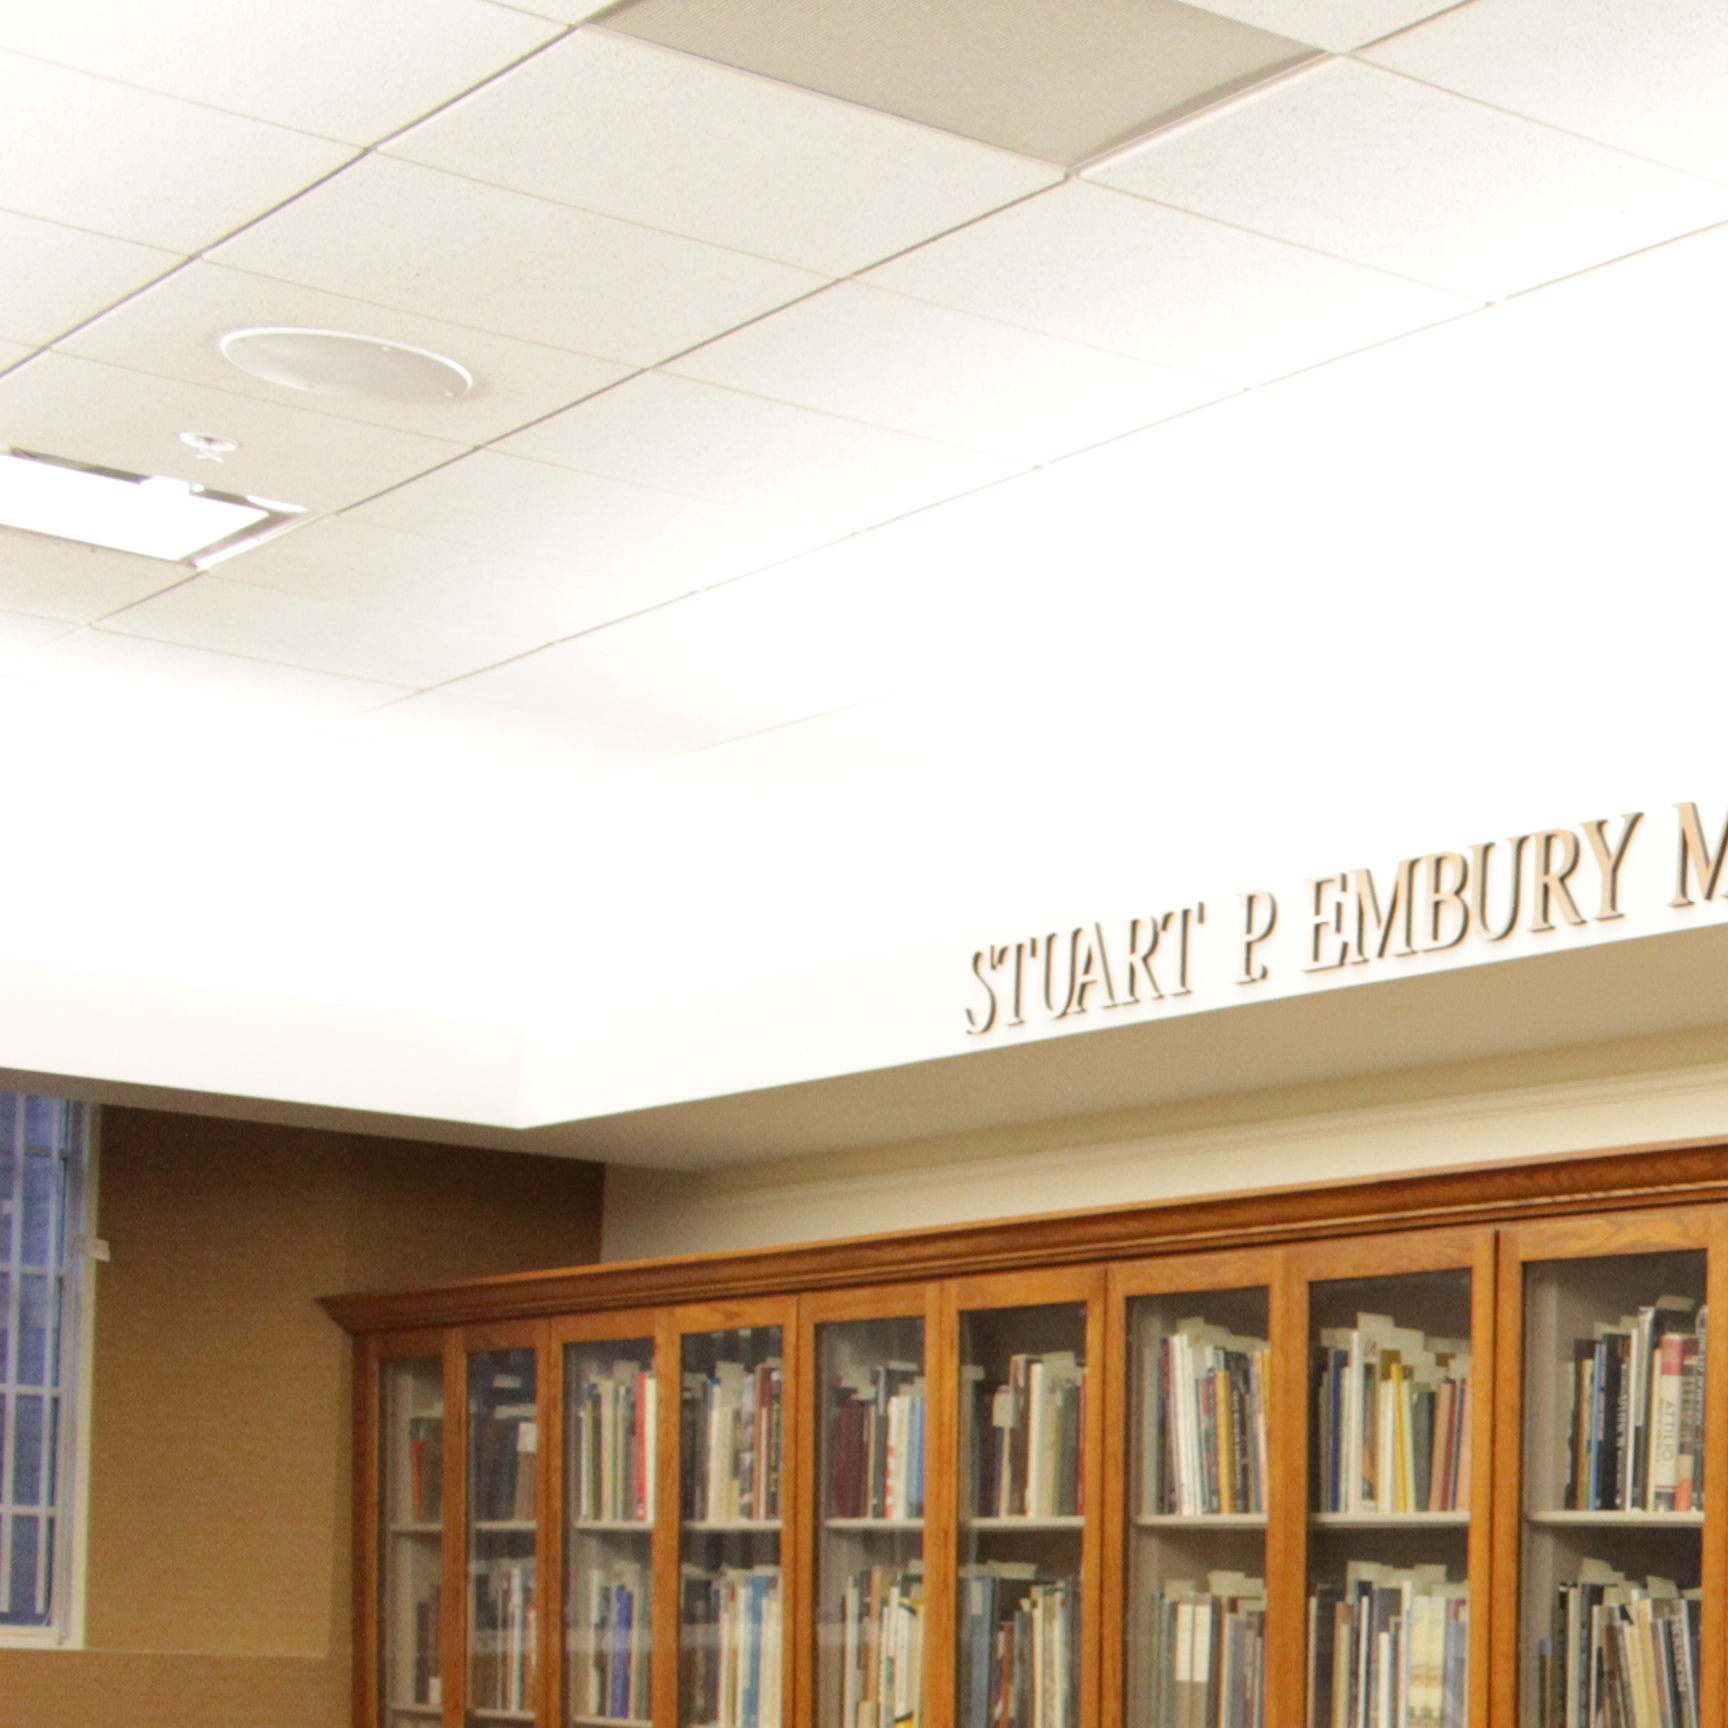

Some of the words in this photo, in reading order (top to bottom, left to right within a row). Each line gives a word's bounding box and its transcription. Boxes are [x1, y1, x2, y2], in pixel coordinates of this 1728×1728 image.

[964, 901, 1206, 1038] STUART
[1302, 811, 1646, 976] EMBURY
[1662, 1400, 1677, 1461] ATTILIO
